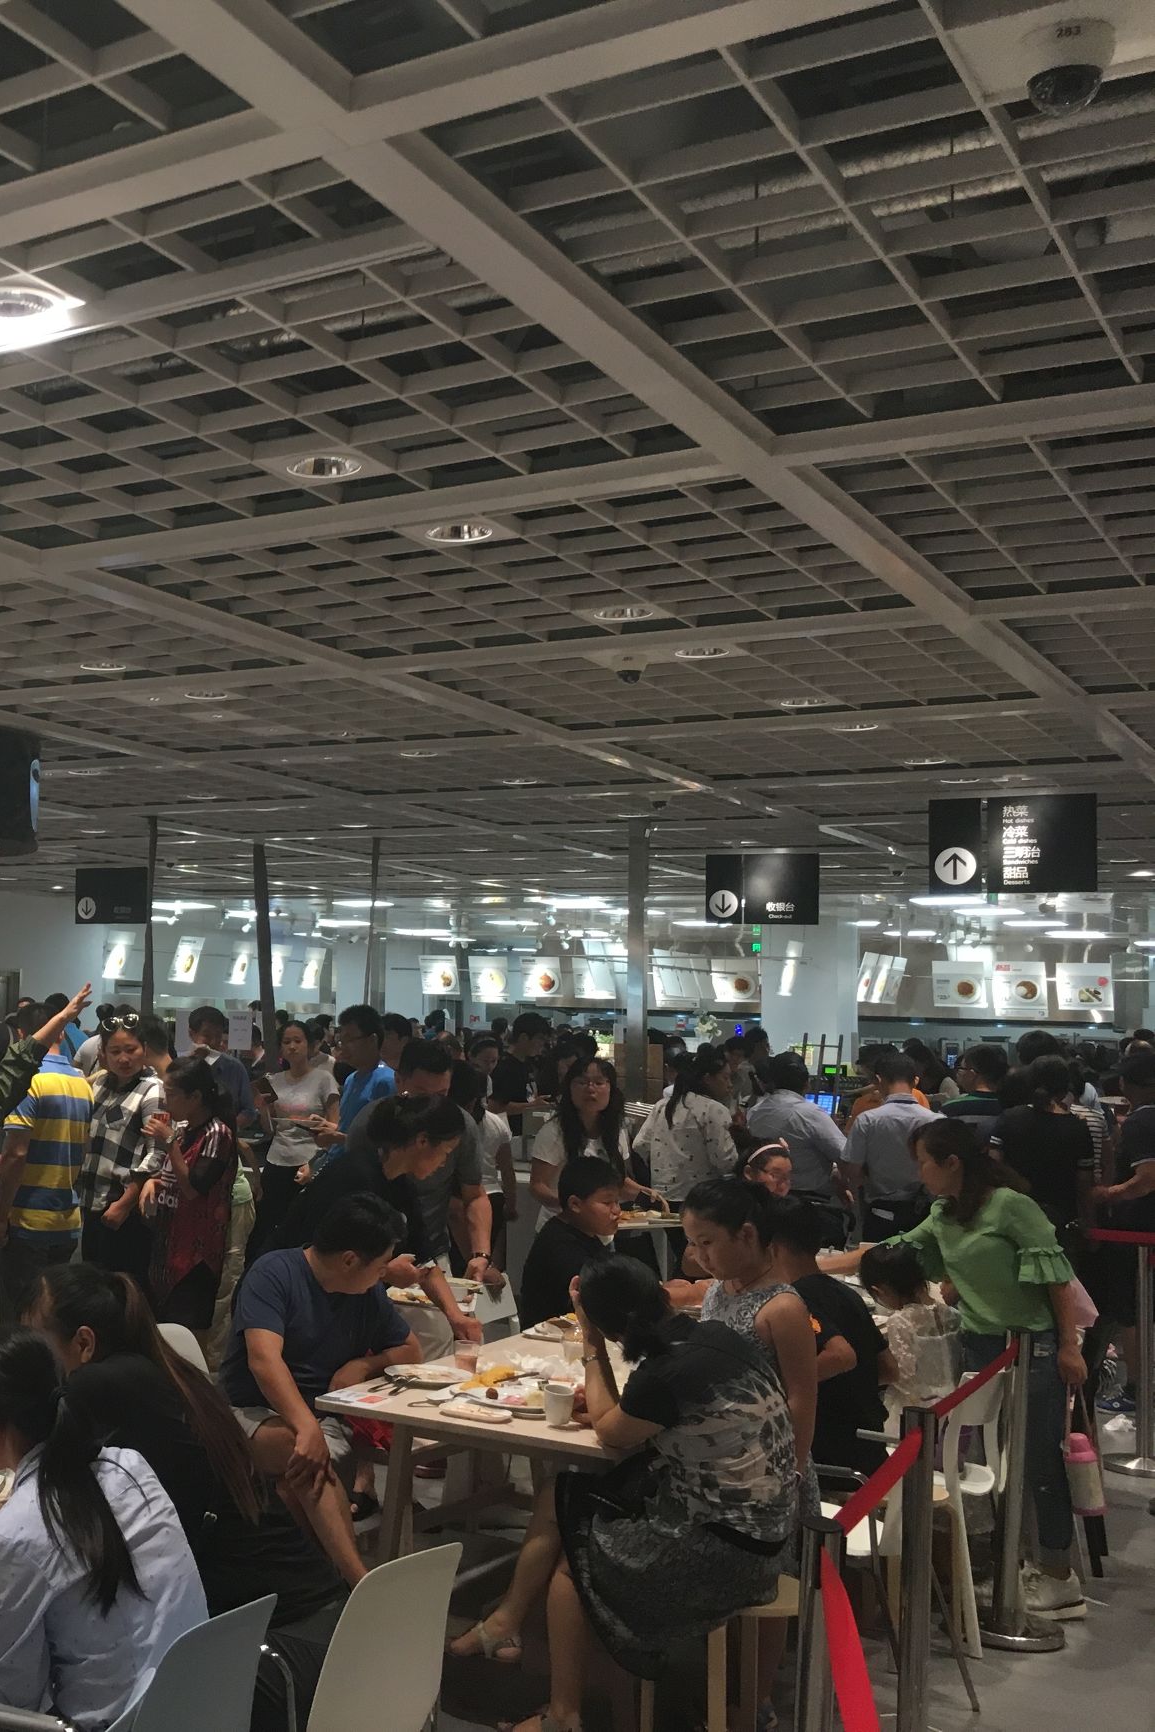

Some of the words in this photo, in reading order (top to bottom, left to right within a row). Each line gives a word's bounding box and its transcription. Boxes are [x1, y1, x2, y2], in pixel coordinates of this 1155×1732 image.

[1003, 805, 1029, 817] 热菜
[1003, 826, 1029, 838] 冷菜
[1003, 846, 1041, 859] 三明治
[1003, 866, 1029, 879] 甜品
[766, 902, 795, 912] 收银台
